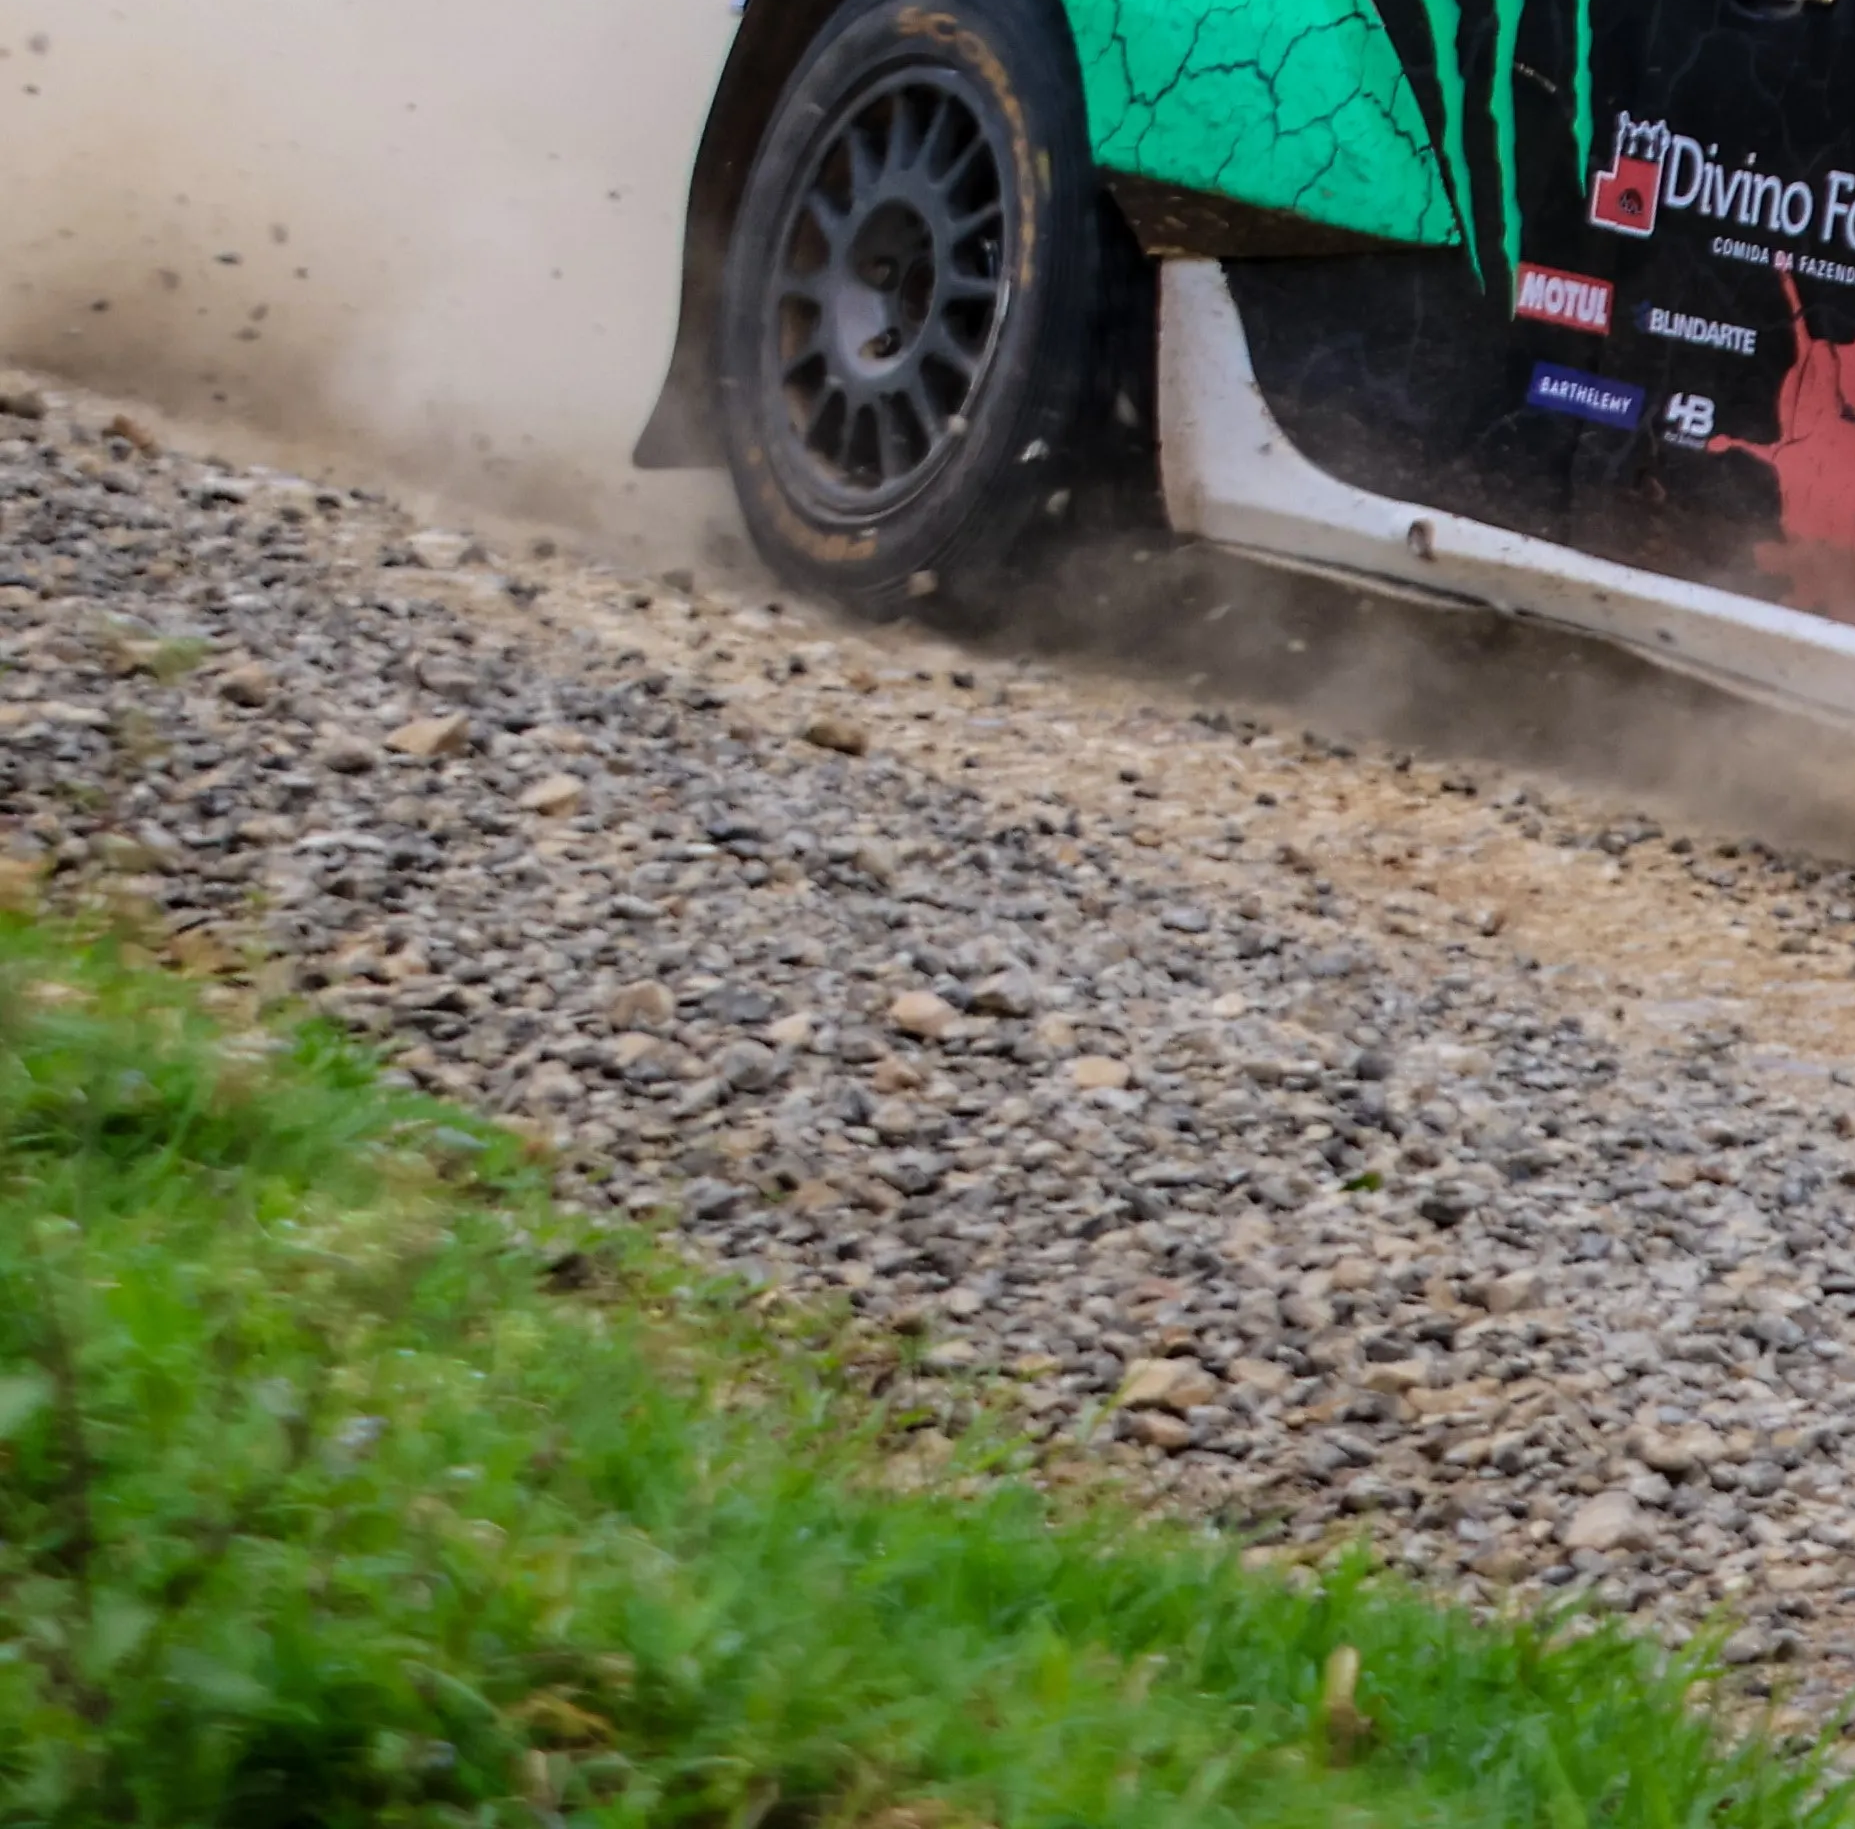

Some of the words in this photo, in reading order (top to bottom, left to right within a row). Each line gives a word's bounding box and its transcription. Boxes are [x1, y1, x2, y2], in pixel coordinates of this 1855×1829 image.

[1664, 134, 1814, 237] Divino
[1712, 236, 1770, 266] COMIDA
[1774, 250, 1794, 271] DA
[1518, 271, 1609, 326] MOTUL
[1649, 307, 1758, 356] BLINDARTE
[1538, 376, 1633, 416] BARTHELEMY
